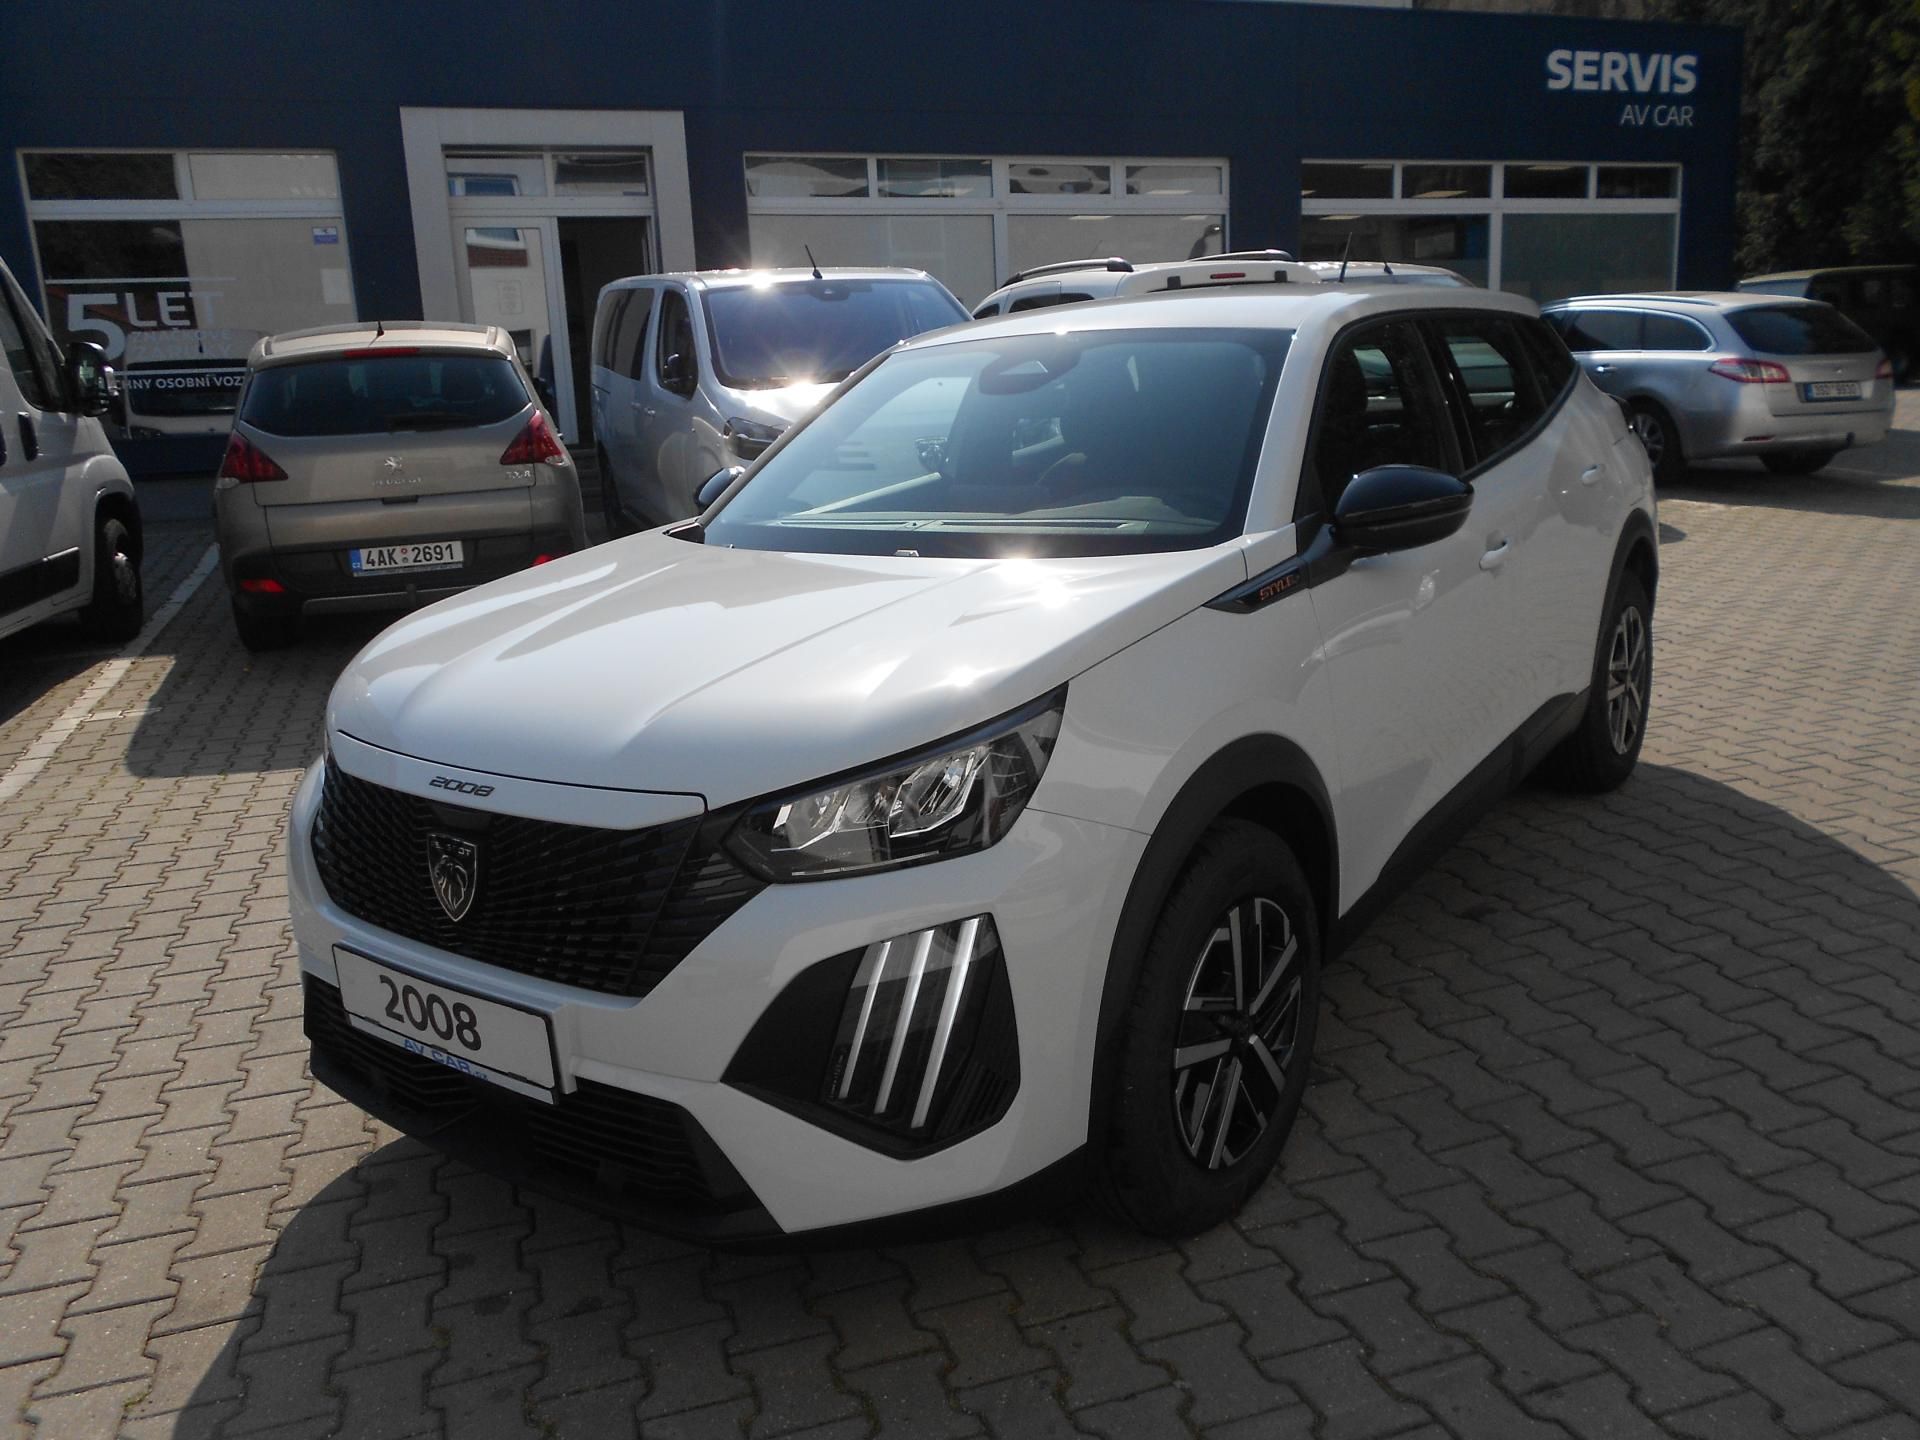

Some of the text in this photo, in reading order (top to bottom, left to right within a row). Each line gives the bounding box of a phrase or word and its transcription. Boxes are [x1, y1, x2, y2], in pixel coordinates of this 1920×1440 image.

[1547, 49, 1698, 94] SERVIS
[1620, 104, 1695, 126] AV CAR
[67, 291, 225, 361] 5 LET
[155, 374, 210, 389] OSOBNÍ
[366, 544, 454, 567] 4AK 2691
[429, 776, 495, 797] 2008
[380, 974, 481, 1051] 2008
[404, 1039, 424, 1055] AV
[431, 1050, 471, 1073] CAR
